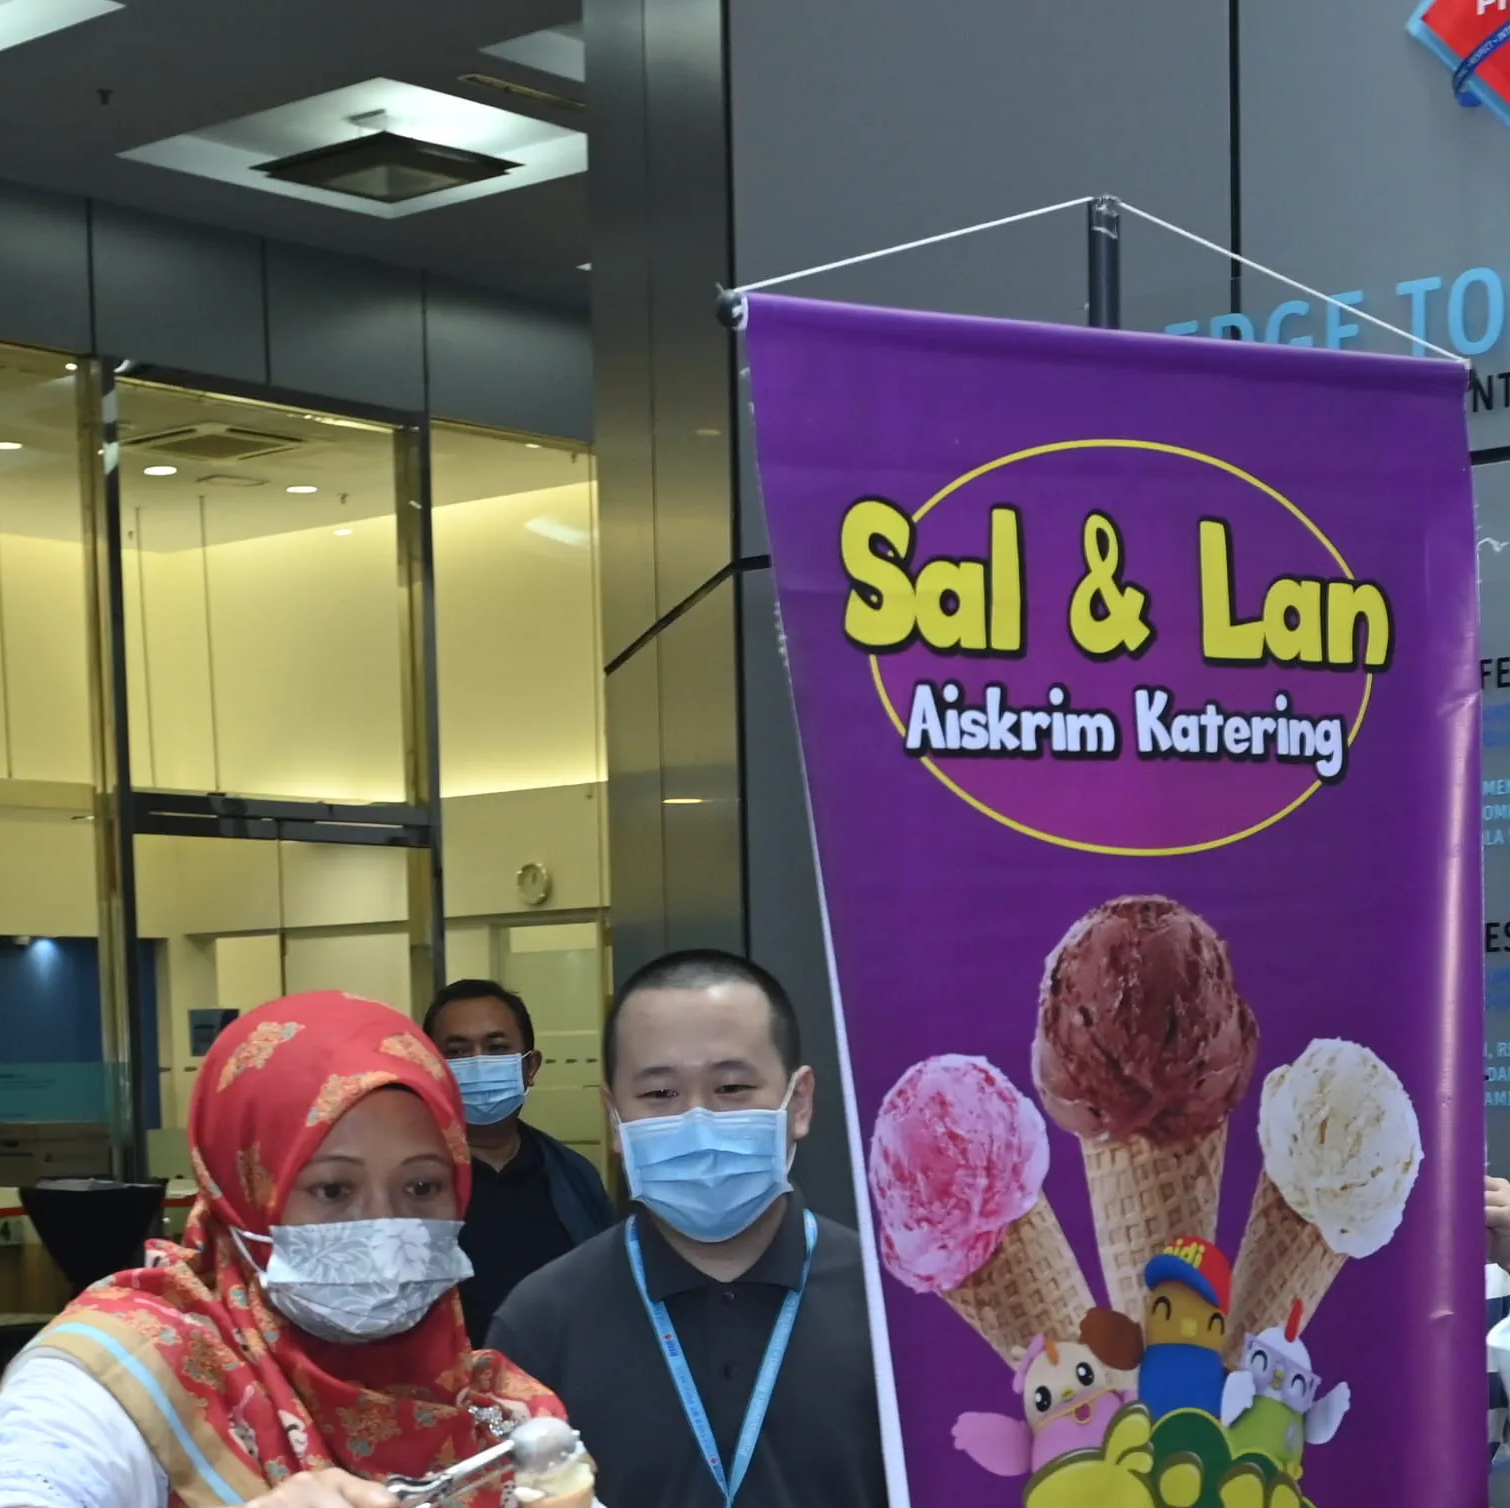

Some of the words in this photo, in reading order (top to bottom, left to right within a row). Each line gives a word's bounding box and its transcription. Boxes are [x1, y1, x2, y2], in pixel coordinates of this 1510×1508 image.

[1396, 266, 1505, 355] TO
[840, 499, 1021, 652] Sal
[1069, 513, 1152, 654] &
[1199, 520, 1390, 665] Lan
[906, 683, 1116, 753] Aiskrim
[1134, 687, 1343, 778] Katering
